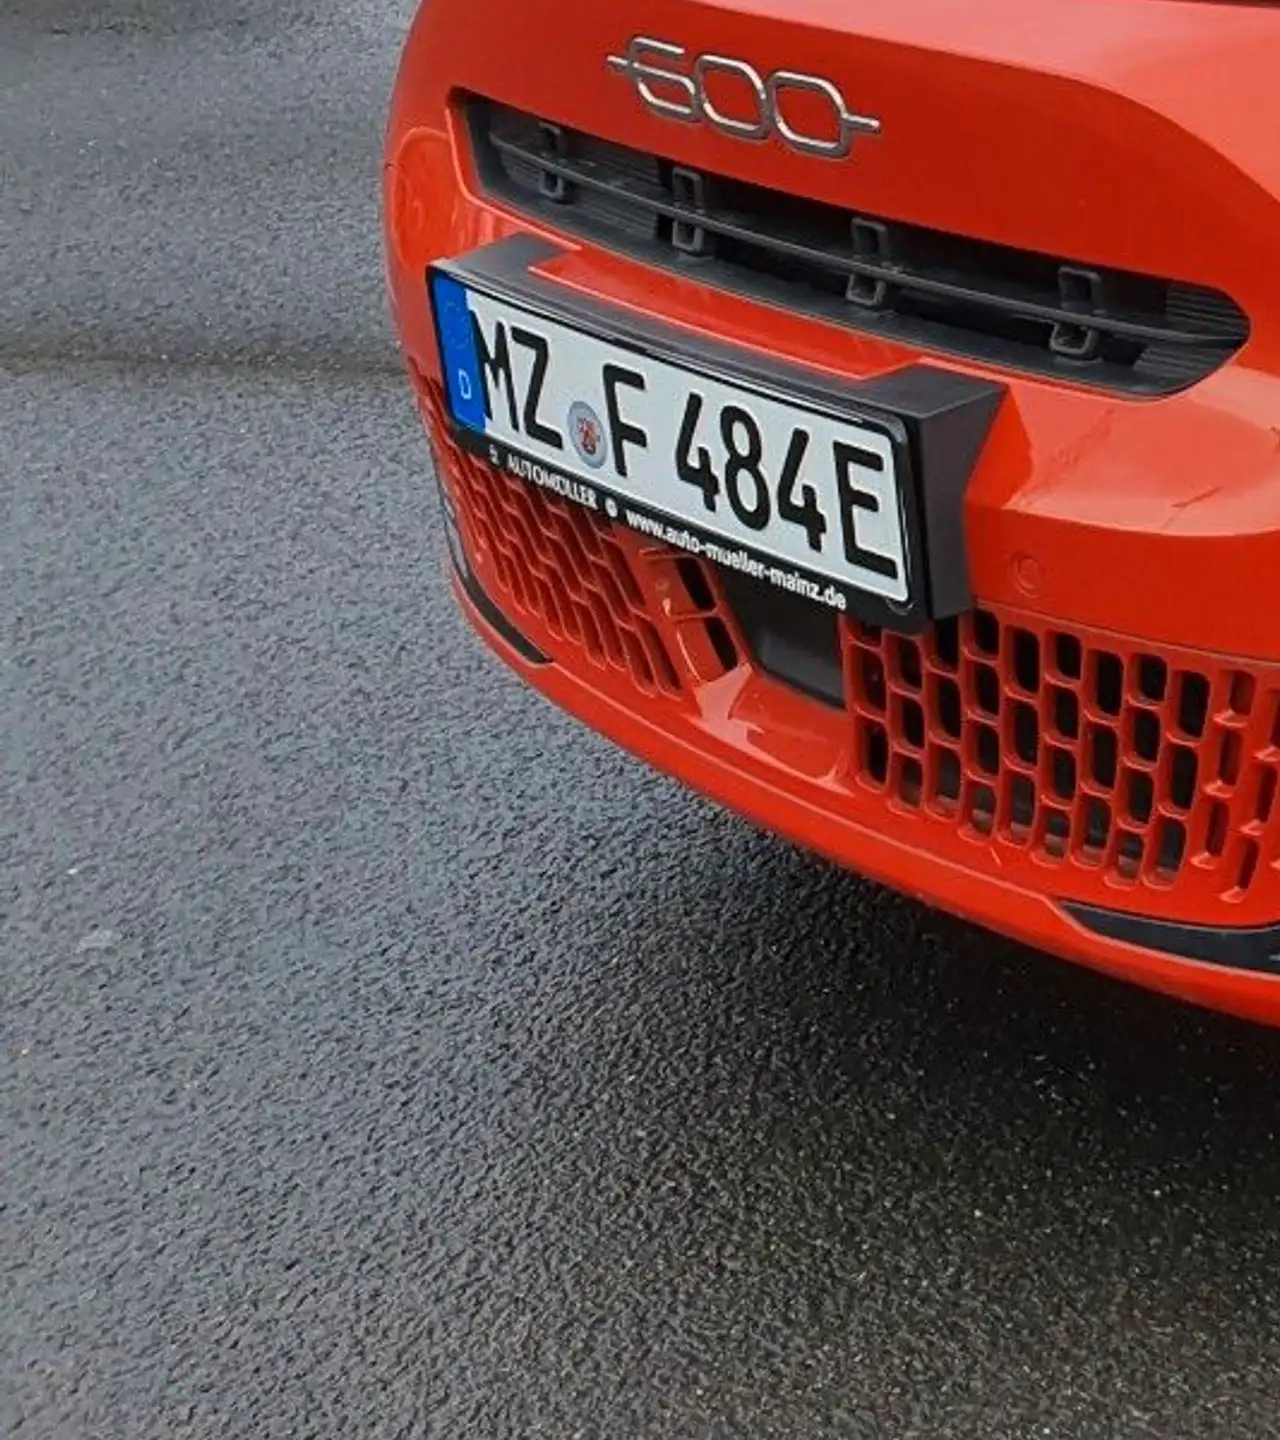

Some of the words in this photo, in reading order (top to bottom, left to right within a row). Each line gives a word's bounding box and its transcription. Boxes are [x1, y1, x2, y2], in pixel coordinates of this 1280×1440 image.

[607, 34, 881, 160] 600
[458, 367, 472, 400] D
[470, 309, 564, 450] MZ
[603, 362, 647, 477] F
[675, 391, 899, 580] 484E
[626, 508, 848, 610] www.auto-mueller-mainz.de
